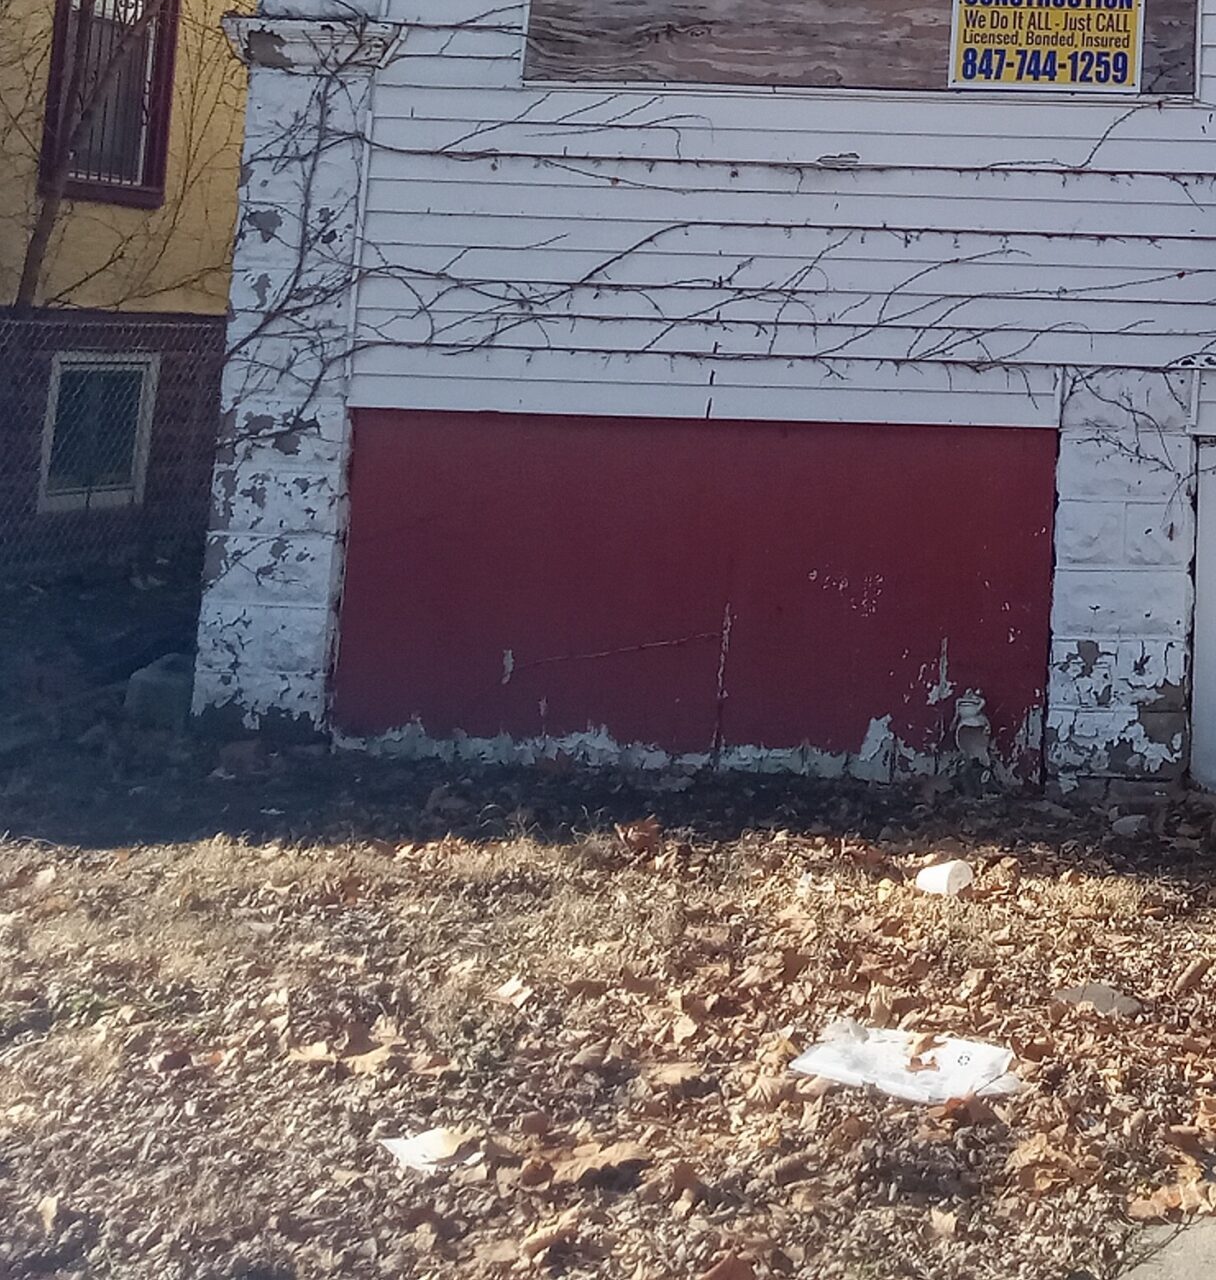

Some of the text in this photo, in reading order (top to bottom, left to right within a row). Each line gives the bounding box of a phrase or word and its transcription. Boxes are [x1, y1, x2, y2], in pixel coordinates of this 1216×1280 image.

[964, 10, 987, 29] We
[990, 11, 1008, 30] Do
[1013, 11, 1024, 30] It
[1027, 12, 1052, 31] ALL
[1062, 12, 1092, 32] Just
[1096, 13, 1131, 33] CALL
[963, 29, 1130, 49] Licensed, Bonded, Insured
[962, 48, 1128, 84] 847-744-1259
